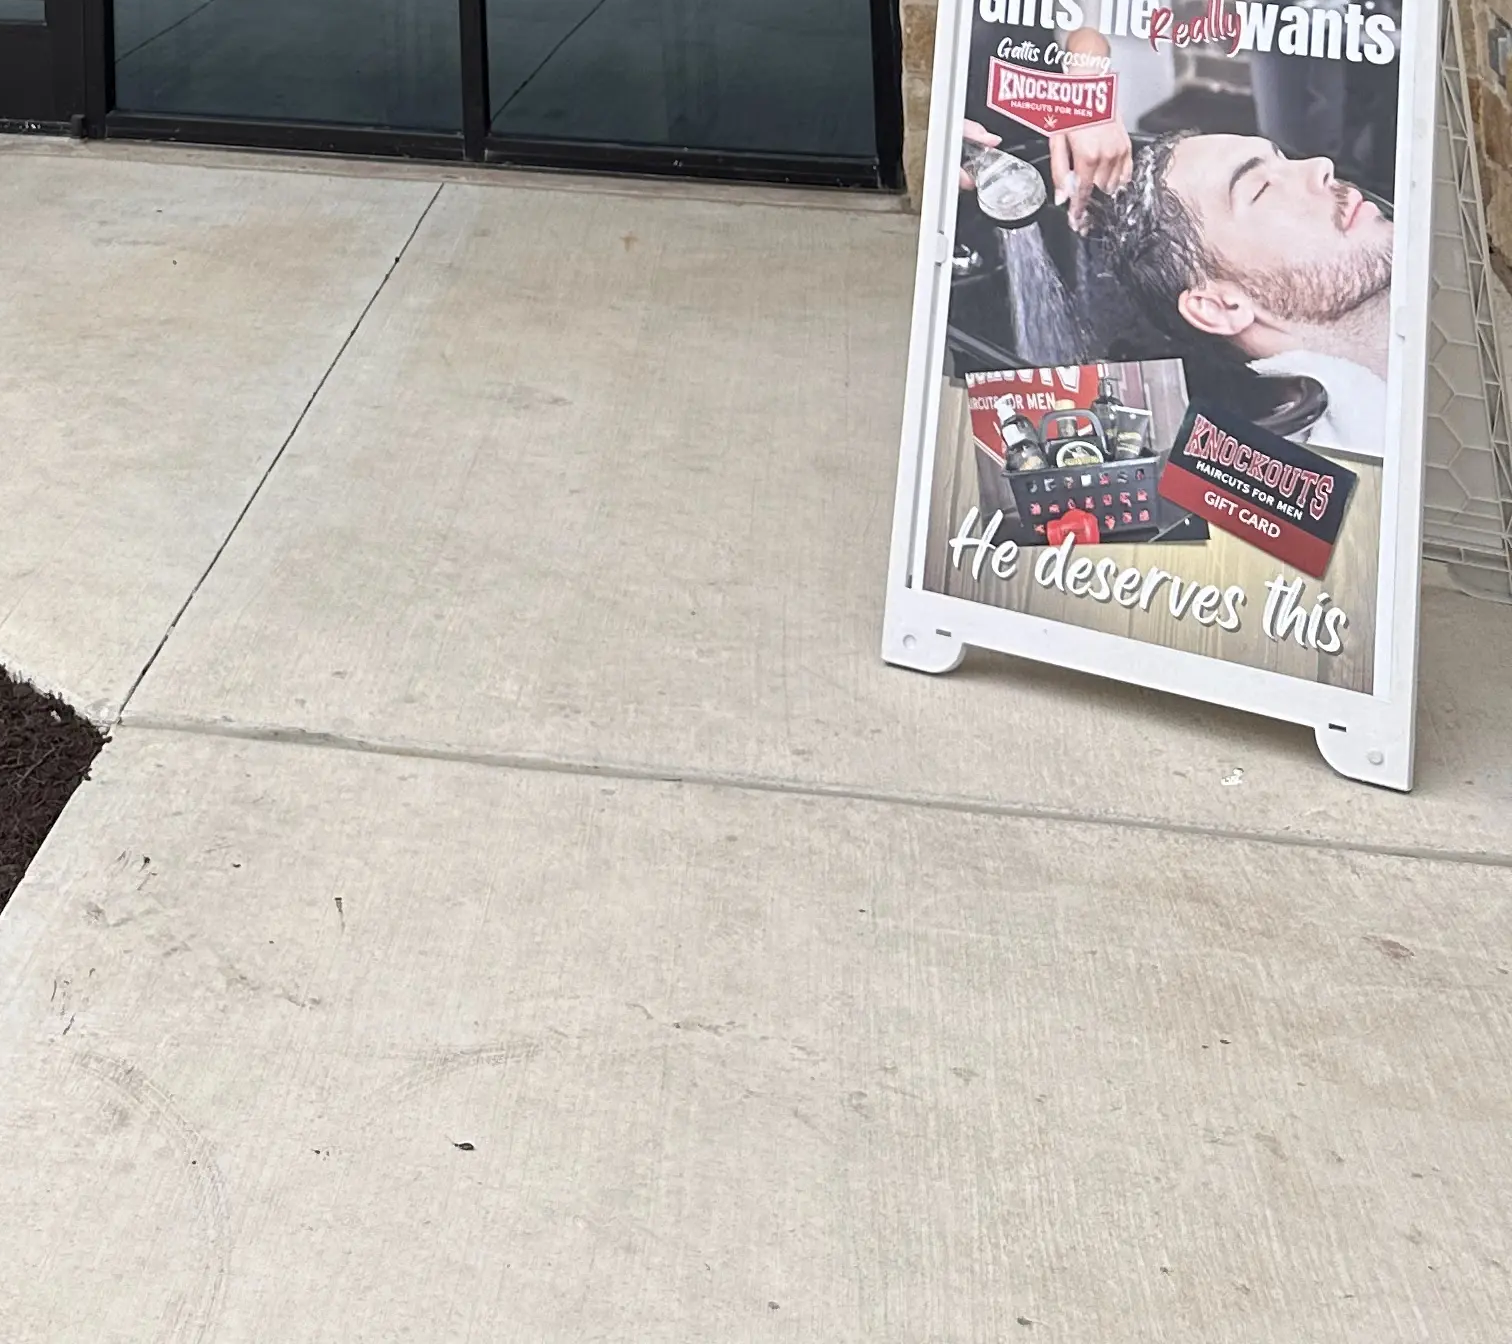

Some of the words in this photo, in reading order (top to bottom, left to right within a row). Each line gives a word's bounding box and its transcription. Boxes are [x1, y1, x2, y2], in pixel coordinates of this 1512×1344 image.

[1236, 0, 1397, 65] wants
[997, 37, 1040, 62] Gattis
[1043, 43, 1111, 76] Crossing
[998, 68, 1108, 114] KNOCKOUTS
[1010, 100, 1053, 113] HAIRCUTS
[1054, 105, 1072, 115] FOR
[1073, 108, 1093, 118] MEN
[1026, 392, 1056, 410] MEN
[1183, 413, 1335, 521] KNOCKOUTS
[1196, 460, 1251, 494] HAIRCUTS
[1251, 488, 1275, 506] FOR
[1276, 500, 1304, 521] MEN
[1204, 491, 1239, 516] GIFT
[1238, 509, 1281, 538] CARD
[949, 506, 1017, 580] He
[1034, 532, 1245, 632] deserves
[1263, 574, 1349, 655] this
